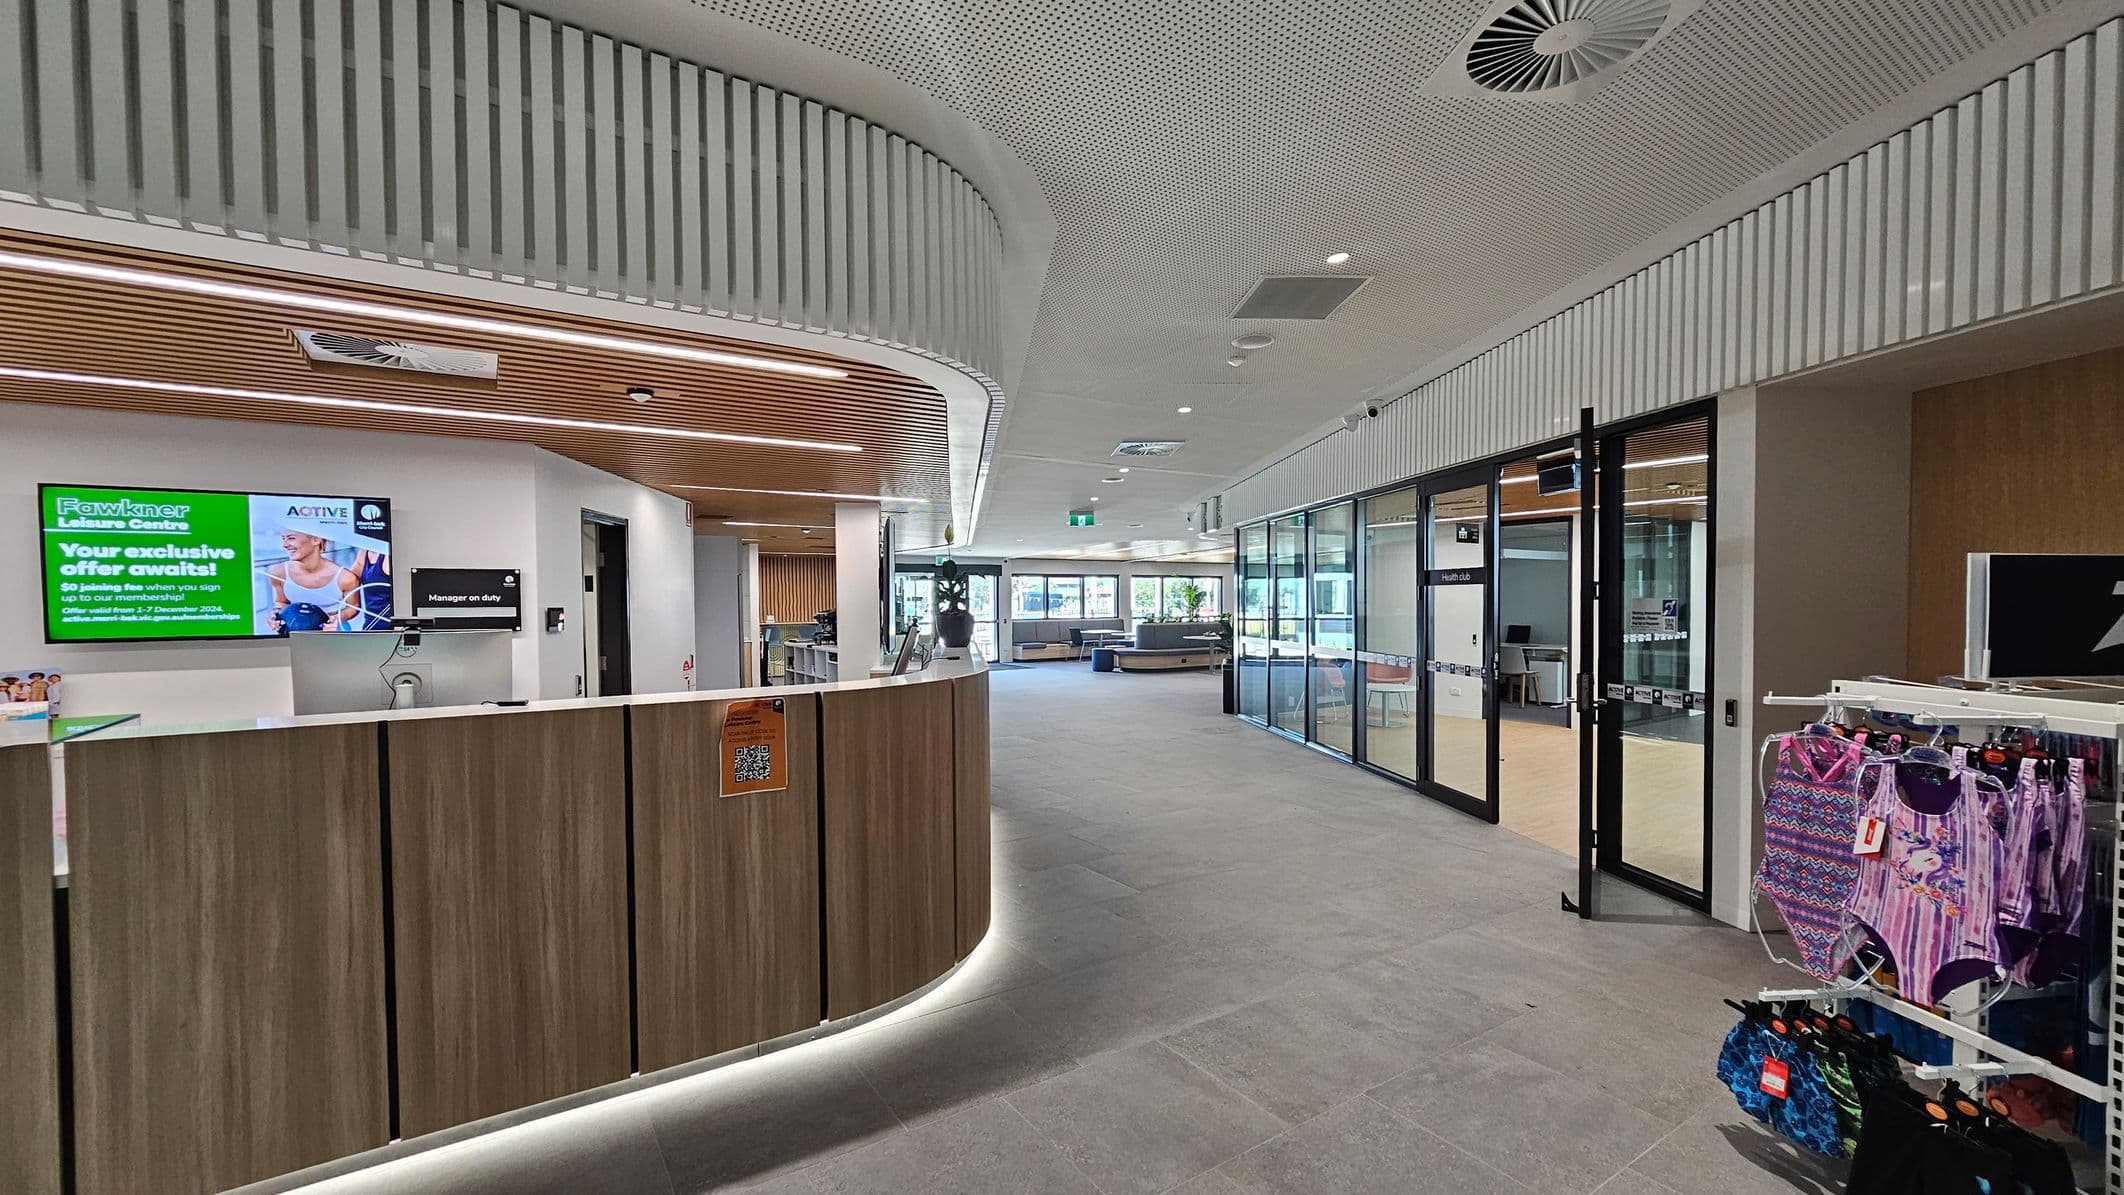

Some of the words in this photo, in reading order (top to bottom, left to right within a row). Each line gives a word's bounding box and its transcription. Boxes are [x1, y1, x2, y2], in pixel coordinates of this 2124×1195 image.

[56, 497, 190, 518] Fawkner
[287, 505, 348, 518] ACTIVE
[57, 517, 126, 529] Leisure
[128, 518, 189, 530] Centre
[58, 543, 123, 558] Your
[124, 544, 235, 559] exclusive
[59, 560, 125, 576] offer
[128, 561, 217, 576] awaits!
[1441, 571, 1459, 582] Health
[1460, 571, 1471, 581] club
[60, 582, 78, 592] $0
[79, 582, 122, 593] joining
[124, 582, 144, 592] fee
[145, 583, 175, 591] when
[177, 584, 196, 592] you
[199, 583, 221, 592] sign
[61, 594, 77, 603] up
[79, 593, 91, 602] to
[94, 594, 113, 602] our
[115, 592, 185, 603] membership!
[428, 594, 468, 603] Manager
[481, 594, 502, 603] duty
[61, 606, 87, 615] Offer
[88, 605, 111, 614] valid
[113, 605, 135, 614] from
[136, 606, 153, 614] 1-7
[154, 605, 198, 613] December
[199, 604, 224, 613] 2024.
